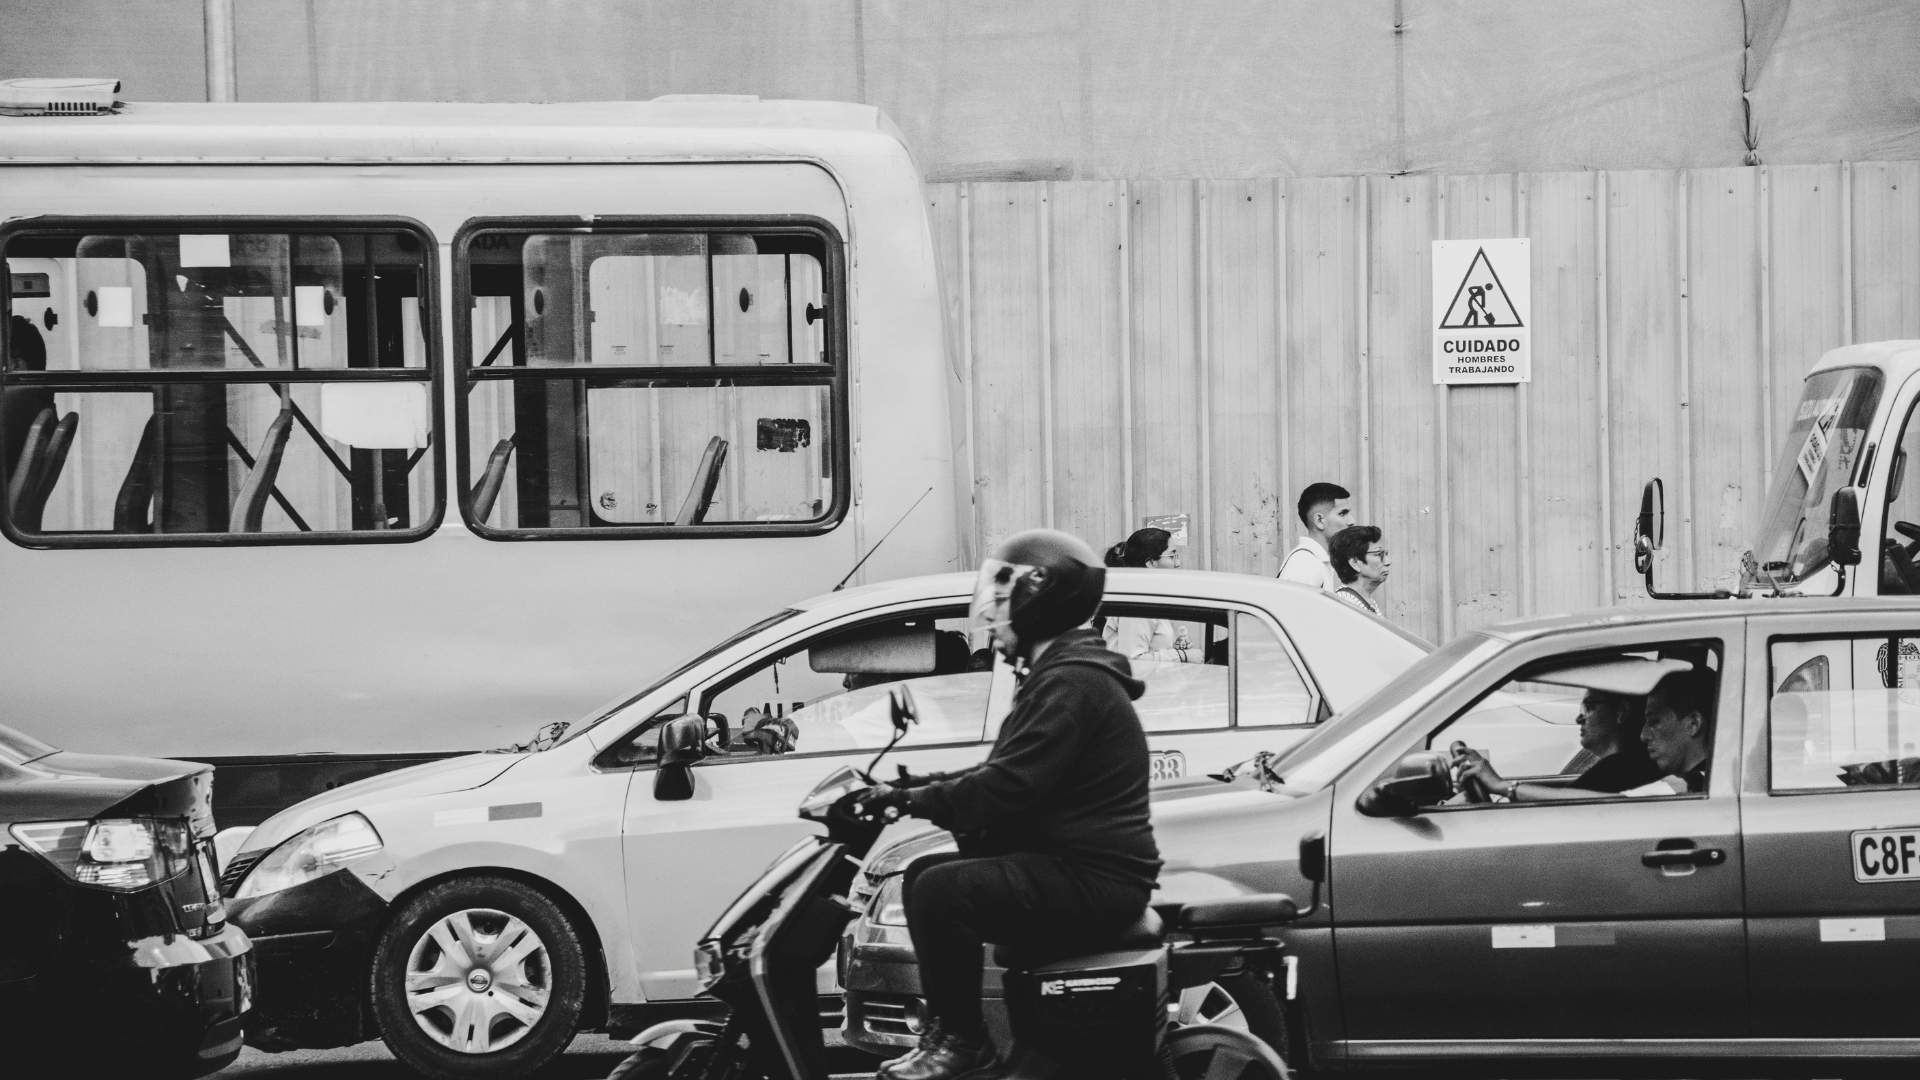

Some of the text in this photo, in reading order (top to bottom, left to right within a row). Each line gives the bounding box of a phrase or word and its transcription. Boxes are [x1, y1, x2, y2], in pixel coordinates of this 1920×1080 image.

[1443, 339, 1520, 353] CUIDADO
[1457, 355, 1506, 364] HOMBRES
[1448, 365, 1515, 374] TRABAJANDO
[1149, 758, 1180, 781] 33
[1859, 835, 1920, 876] C8F
